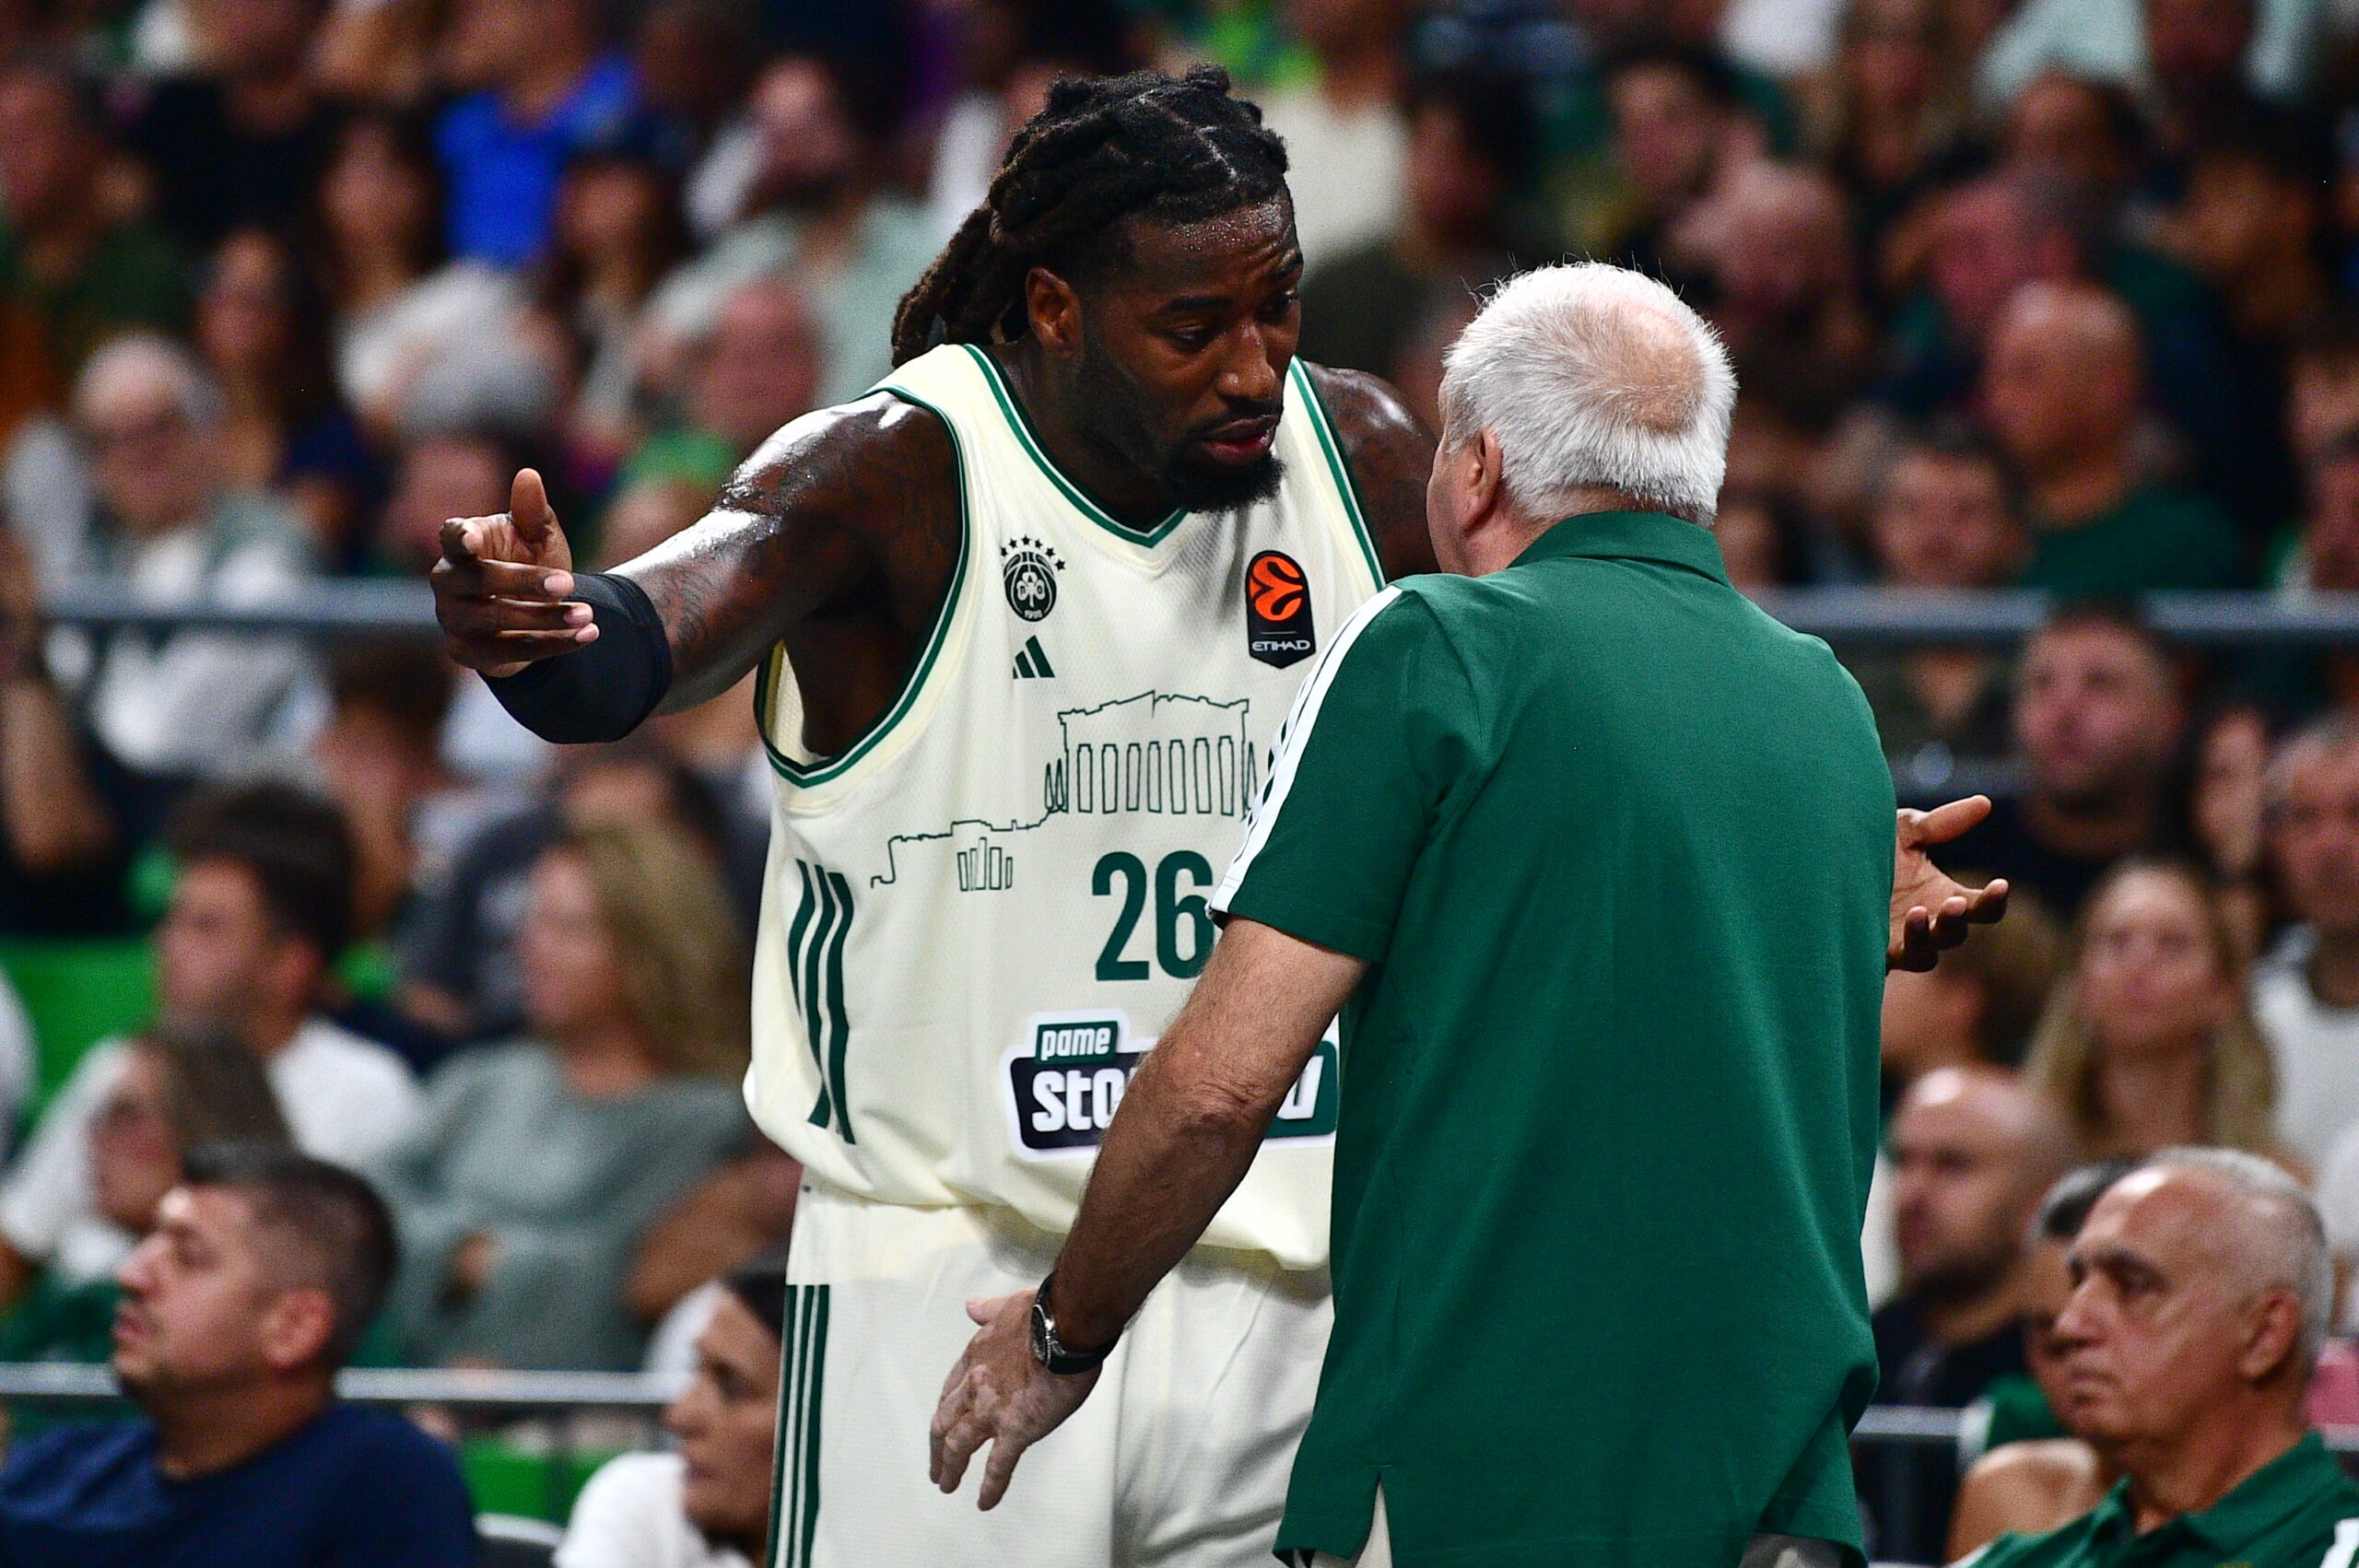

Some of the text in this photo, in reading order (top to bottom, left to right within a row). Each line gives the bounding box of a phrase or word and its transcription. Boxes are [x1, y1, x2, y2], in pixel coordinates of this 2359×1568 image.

[1251, 639, 1311, 651] ETIHAD
[1092, 850, 1214, 981] 26
[1040, 1027, 1111, 1061] pame
[1032, 1067, 1135, 1132] sto
